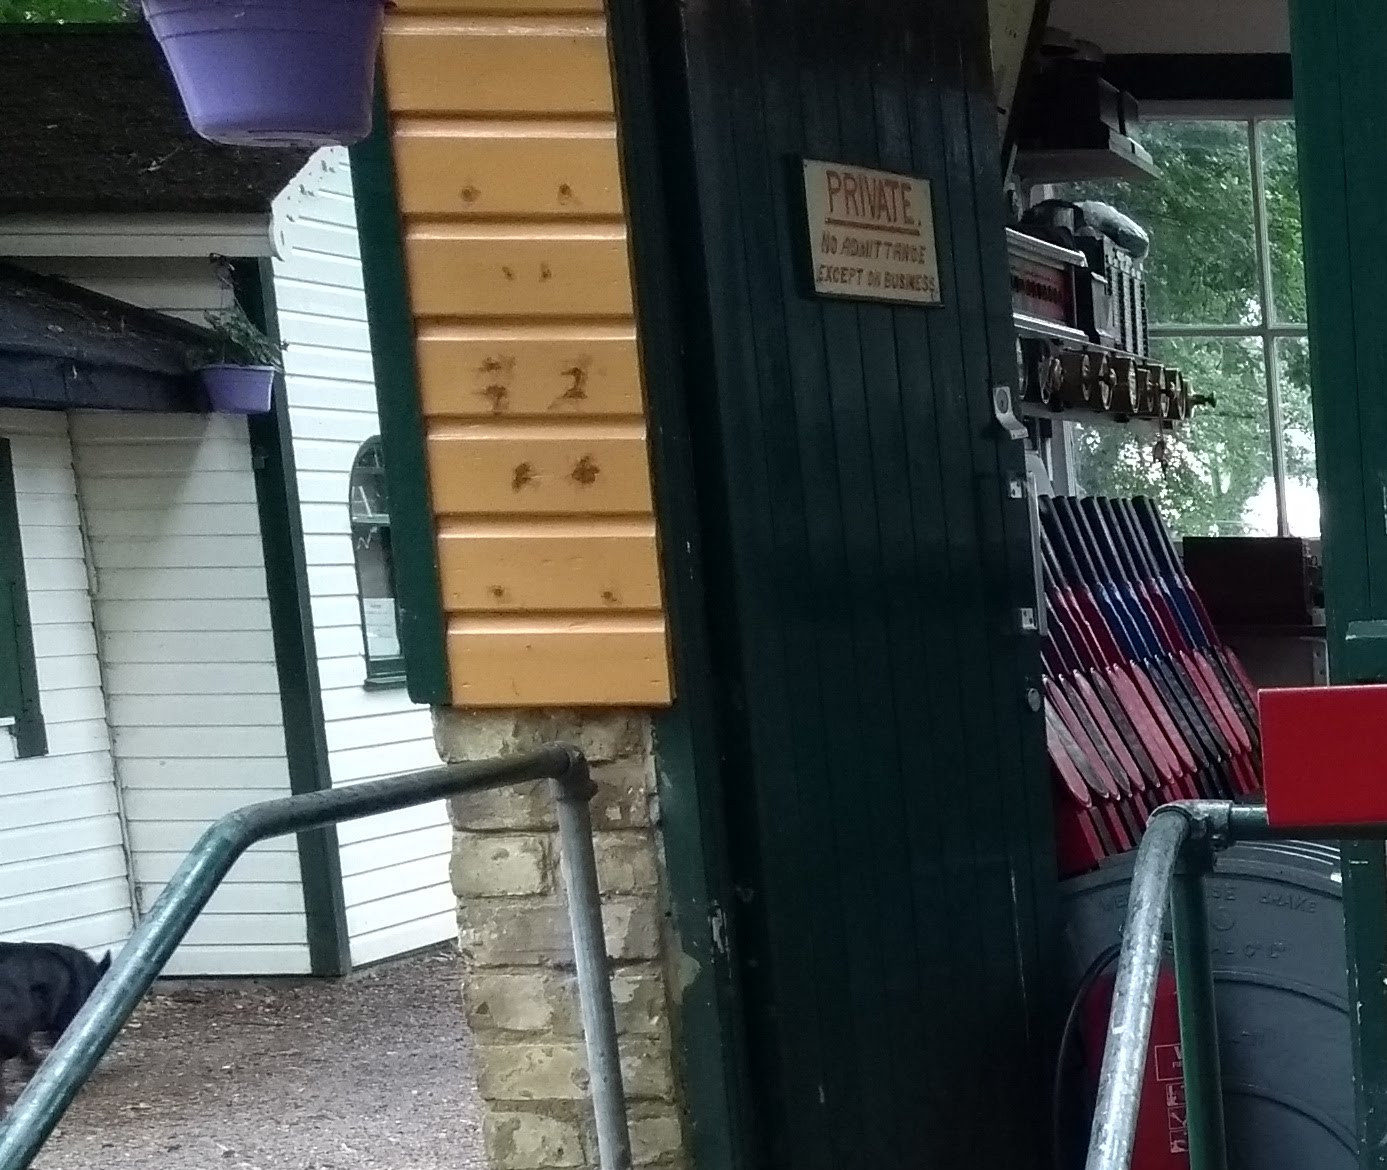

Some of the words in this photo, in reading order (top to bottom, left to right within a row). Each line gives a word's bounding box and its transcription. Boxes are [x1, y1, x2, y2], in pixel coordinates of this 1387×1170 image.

[826, 170, 922, 226] PRIVATE.
[821, 231, 838, 255] NO
[840, 237, 926, 264] ADMITTANCE
[817, 264, 863, 285] EXCEPT
[867, 268, 881, 287] ON
[884, 271, 935, 292] BUSINESS
